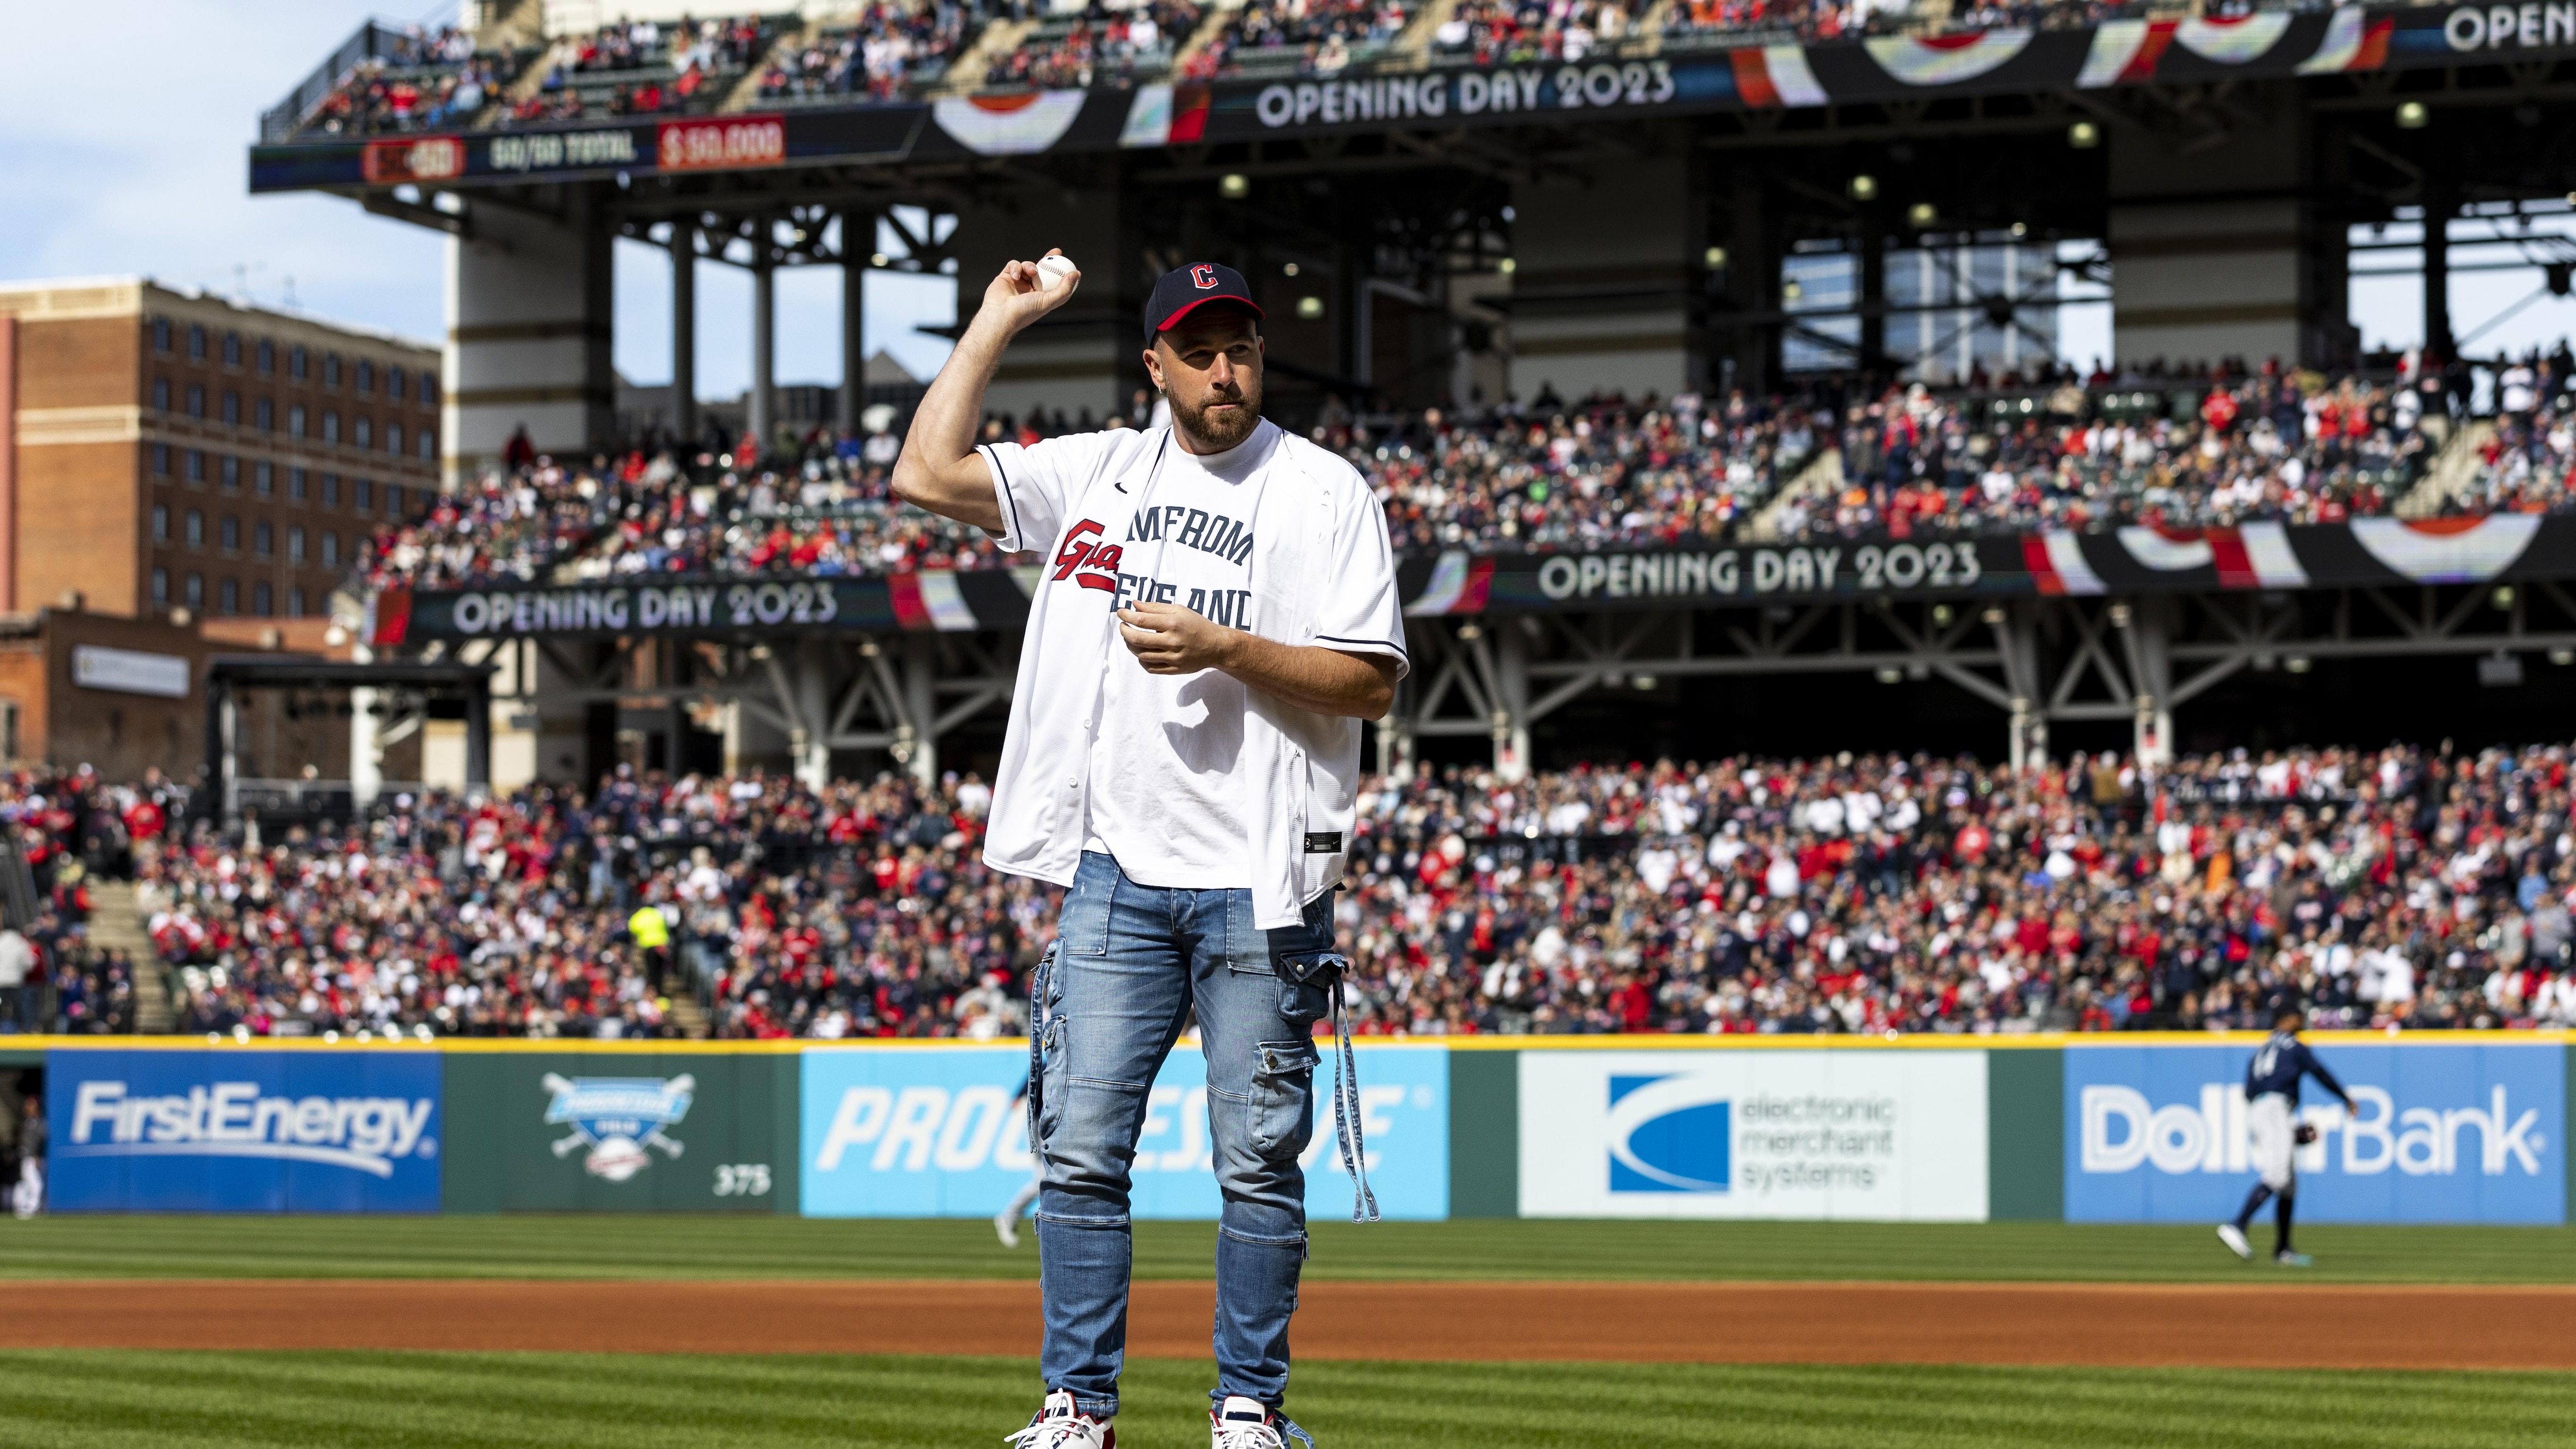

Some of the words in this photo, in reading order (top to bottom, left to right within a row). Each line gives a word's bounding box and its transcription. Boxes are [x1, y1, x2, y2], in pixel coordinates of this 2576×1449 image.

[1257, 75, 1446, 127] OPENING
[1459, 69, 1544, 114] DAY
[1555, 61, 1676, 108] 2023
[1190, 264, 1218, 289] C
[1539, 549, 1739, 600] OPENING
[1754, 546, 1842, 592] DAY
[1857, 542, 1981, 589] 2023
[452, 587, 630, 634] OPENING
[639, 586, 718, 627] DAY
[727, 581, 838, 625] 2023
[1741, 1096, 1896, 1125] electronic
[1741, 1126, 1893, 1156] merchant
[1741, 1161, 1877, 1195] systems
